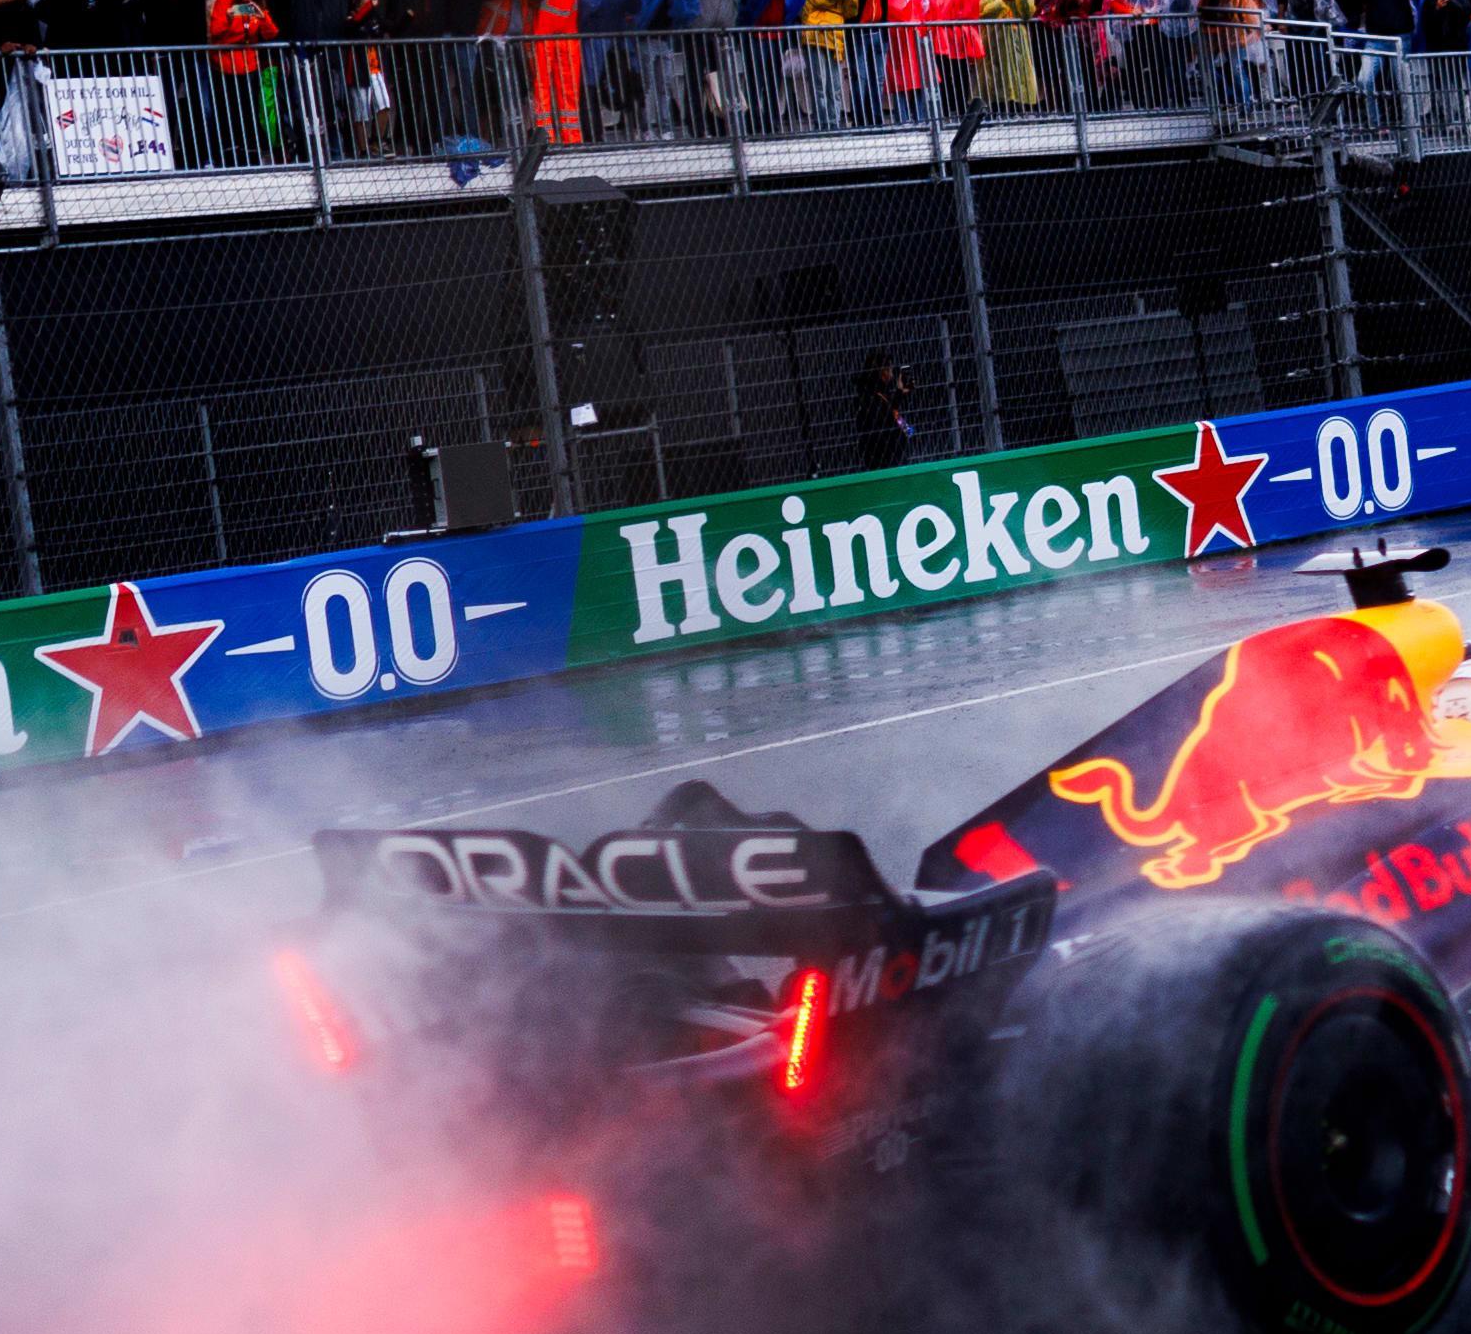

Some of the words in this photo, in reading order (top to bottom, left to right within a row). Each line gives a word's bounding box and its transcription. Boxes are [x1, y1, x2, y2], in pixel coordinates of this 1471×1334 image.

[619, 470, 1150, 644] Heineken
[1316, 408, 1415, 521] 0.0
[302, 557, 459, 700] 0.0
[378, 837, 828, 910] ORACLE
[829, 913, 991, 1017] Mobil
[1009, 907, 1028, 954] 1
